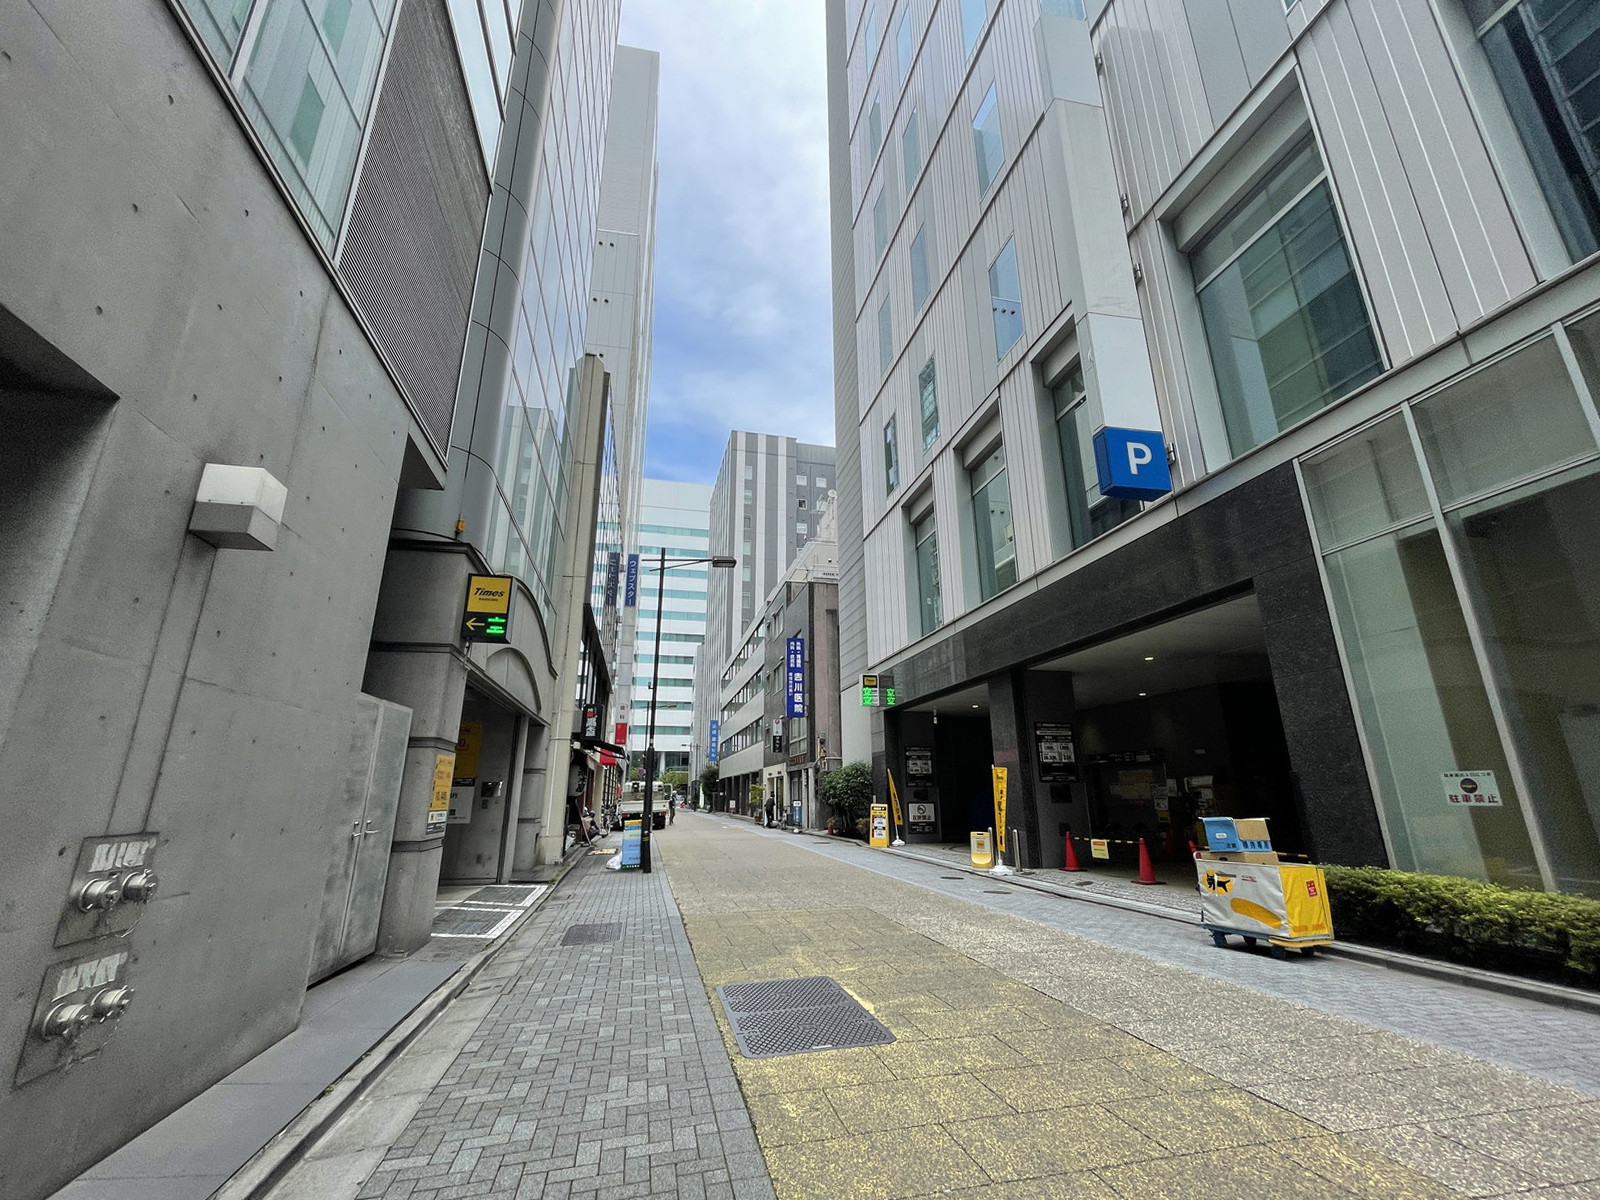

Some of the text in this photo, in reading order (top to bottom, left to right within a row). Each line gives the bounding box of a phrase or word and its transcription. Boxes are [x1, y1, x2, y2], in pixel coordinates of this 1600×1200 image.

[1126, 441, 1152, 475] P
[474, 587, 505, 597] Times
[1448, 793, 1499, 803] 駐車禁止
